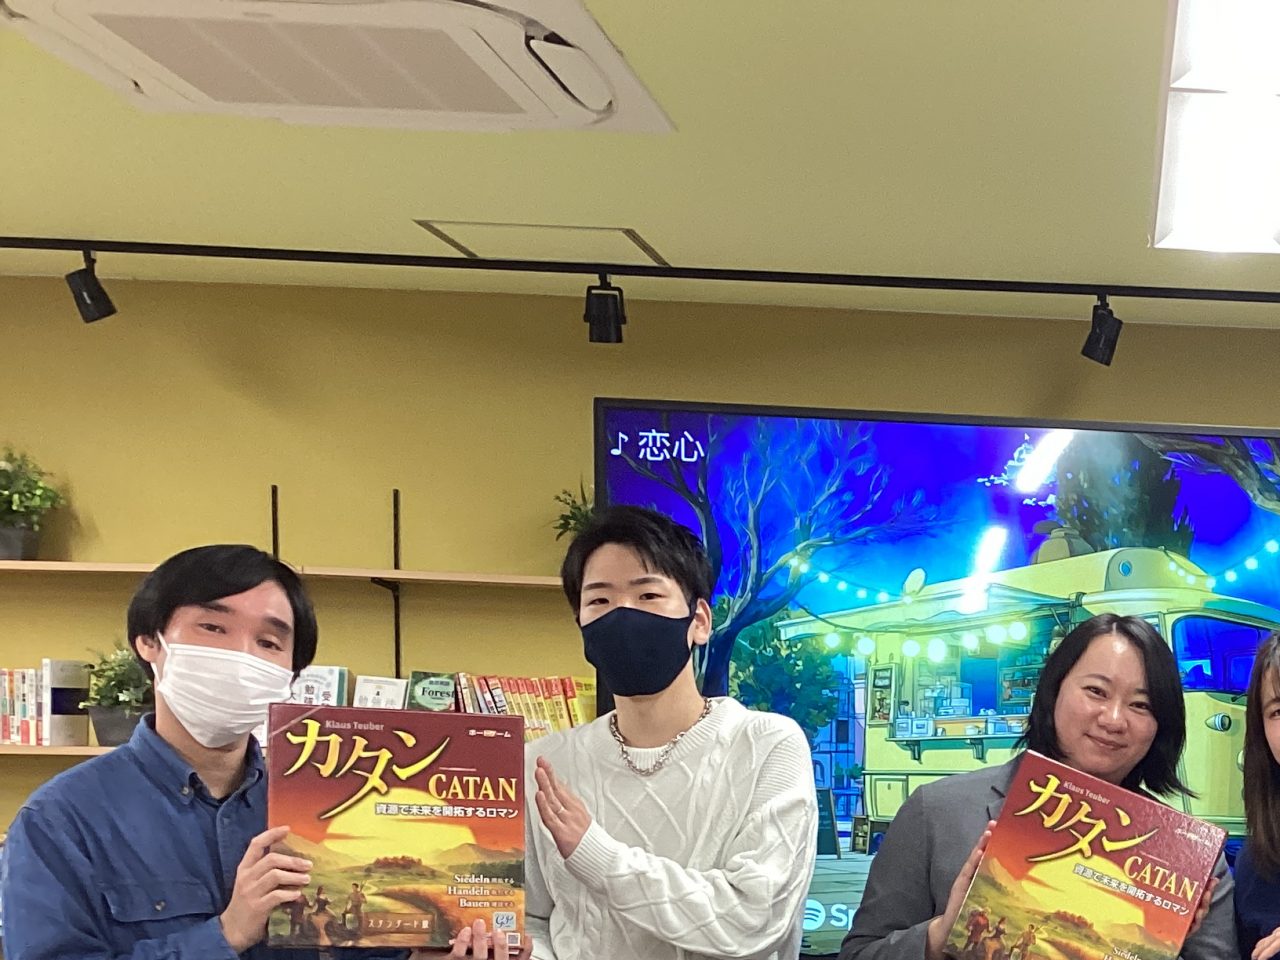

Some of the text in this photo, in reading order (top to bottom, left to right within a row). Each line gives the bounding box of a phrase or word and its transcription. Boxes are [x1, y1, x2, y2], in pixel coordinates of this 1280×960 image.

[638, 429, 705, 462] 恋心
[325, 721, 384, 731] Klaus Teuber
[284, 718, 450, 819] カタン
[428, 774, 518, 802] CATAN
[1063, 781, 1110, 805] Klaus Teuber
[376, 803, 519, 819] 資源で未来を開拓するロマン
[1014, 774, 1160, 862] カタン
[454, 874, 490, 884] Siedeln
[1123, 855, 1200, 902] CATAN
[448, 886, 490, 896] Handeln
[459, 898, 490, 908] Bauen
